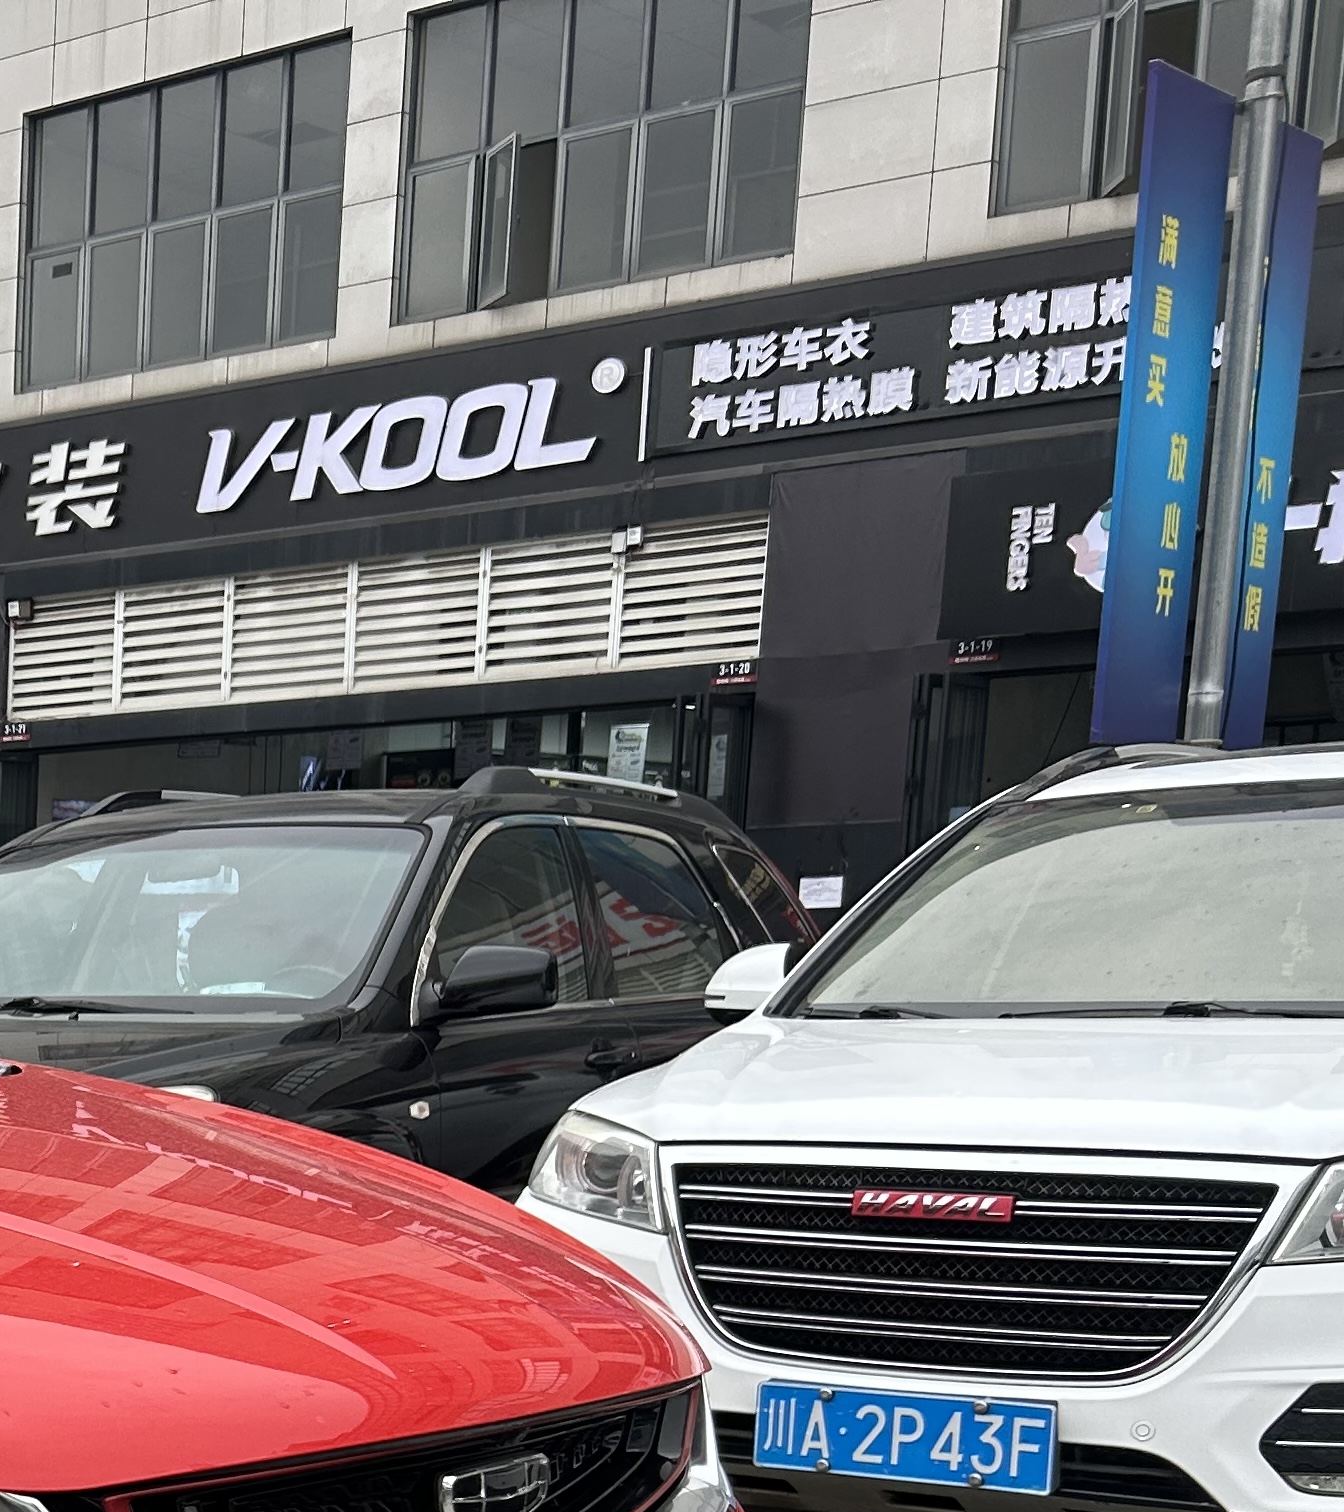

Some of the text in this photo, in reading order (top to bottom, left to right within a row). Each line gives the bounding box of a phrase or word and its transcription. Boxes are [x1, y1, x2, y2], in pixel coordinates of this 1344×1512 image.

[691, 317, 871, 387] 隐形车衣
[1145, 214, 1180, 407] 满意买
[688, 365, 916, 439] 汽车隔热膜
[196, 378, 597, 514] V-KOOL
[1006, 505, 1033, 592] FINGERS
[1032, 503, 1056, 544] TEN
[1156, 432, 1188, 617] 放心开
[1243, 458, 1276, 631] 不造假
[856, 1191, 1006, 1219] HAVAL
